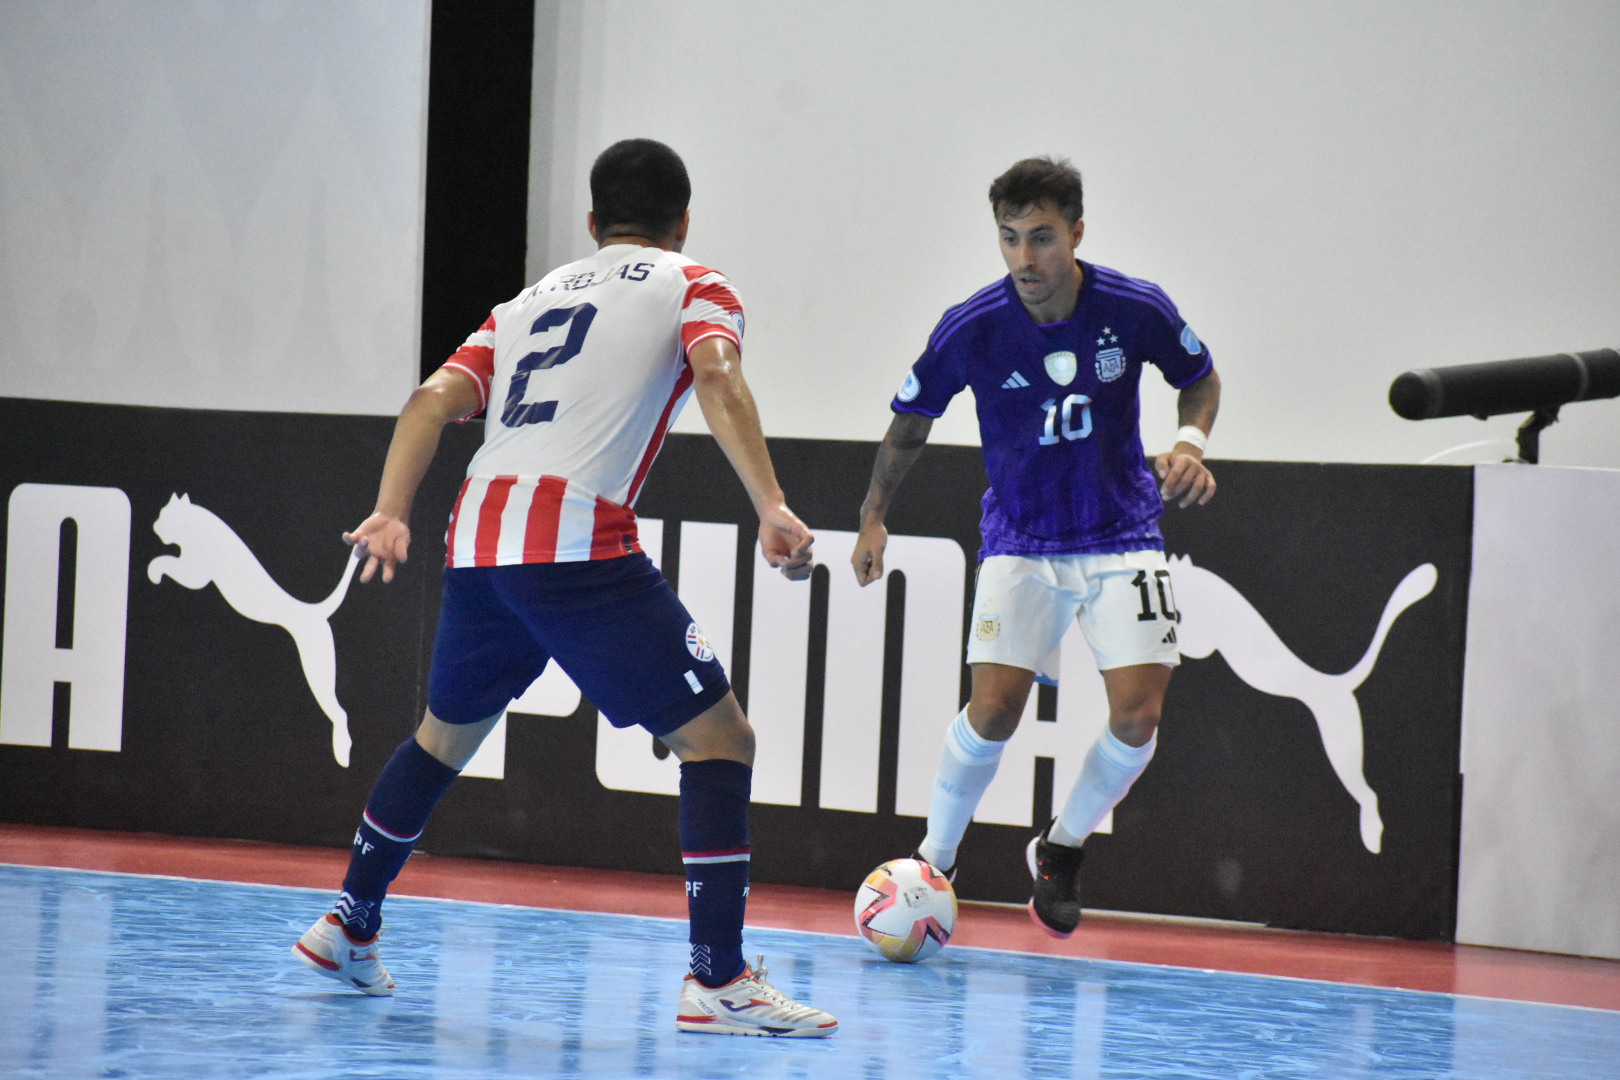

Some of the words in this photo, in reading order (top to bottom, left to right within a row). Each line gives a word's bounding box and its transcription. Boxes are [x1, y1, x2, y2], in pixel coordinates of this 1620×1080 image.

[550, 262, 656, 293] ROJAS
[500, 302, 598, 427] 2
[1039, 393, 1093, 445] 10
[0, 482, 132, 753] A
[1131, 569, 1181, 624] 10
[354, 828, 375, 855] PF
[685, 880, 704, 897] PF
